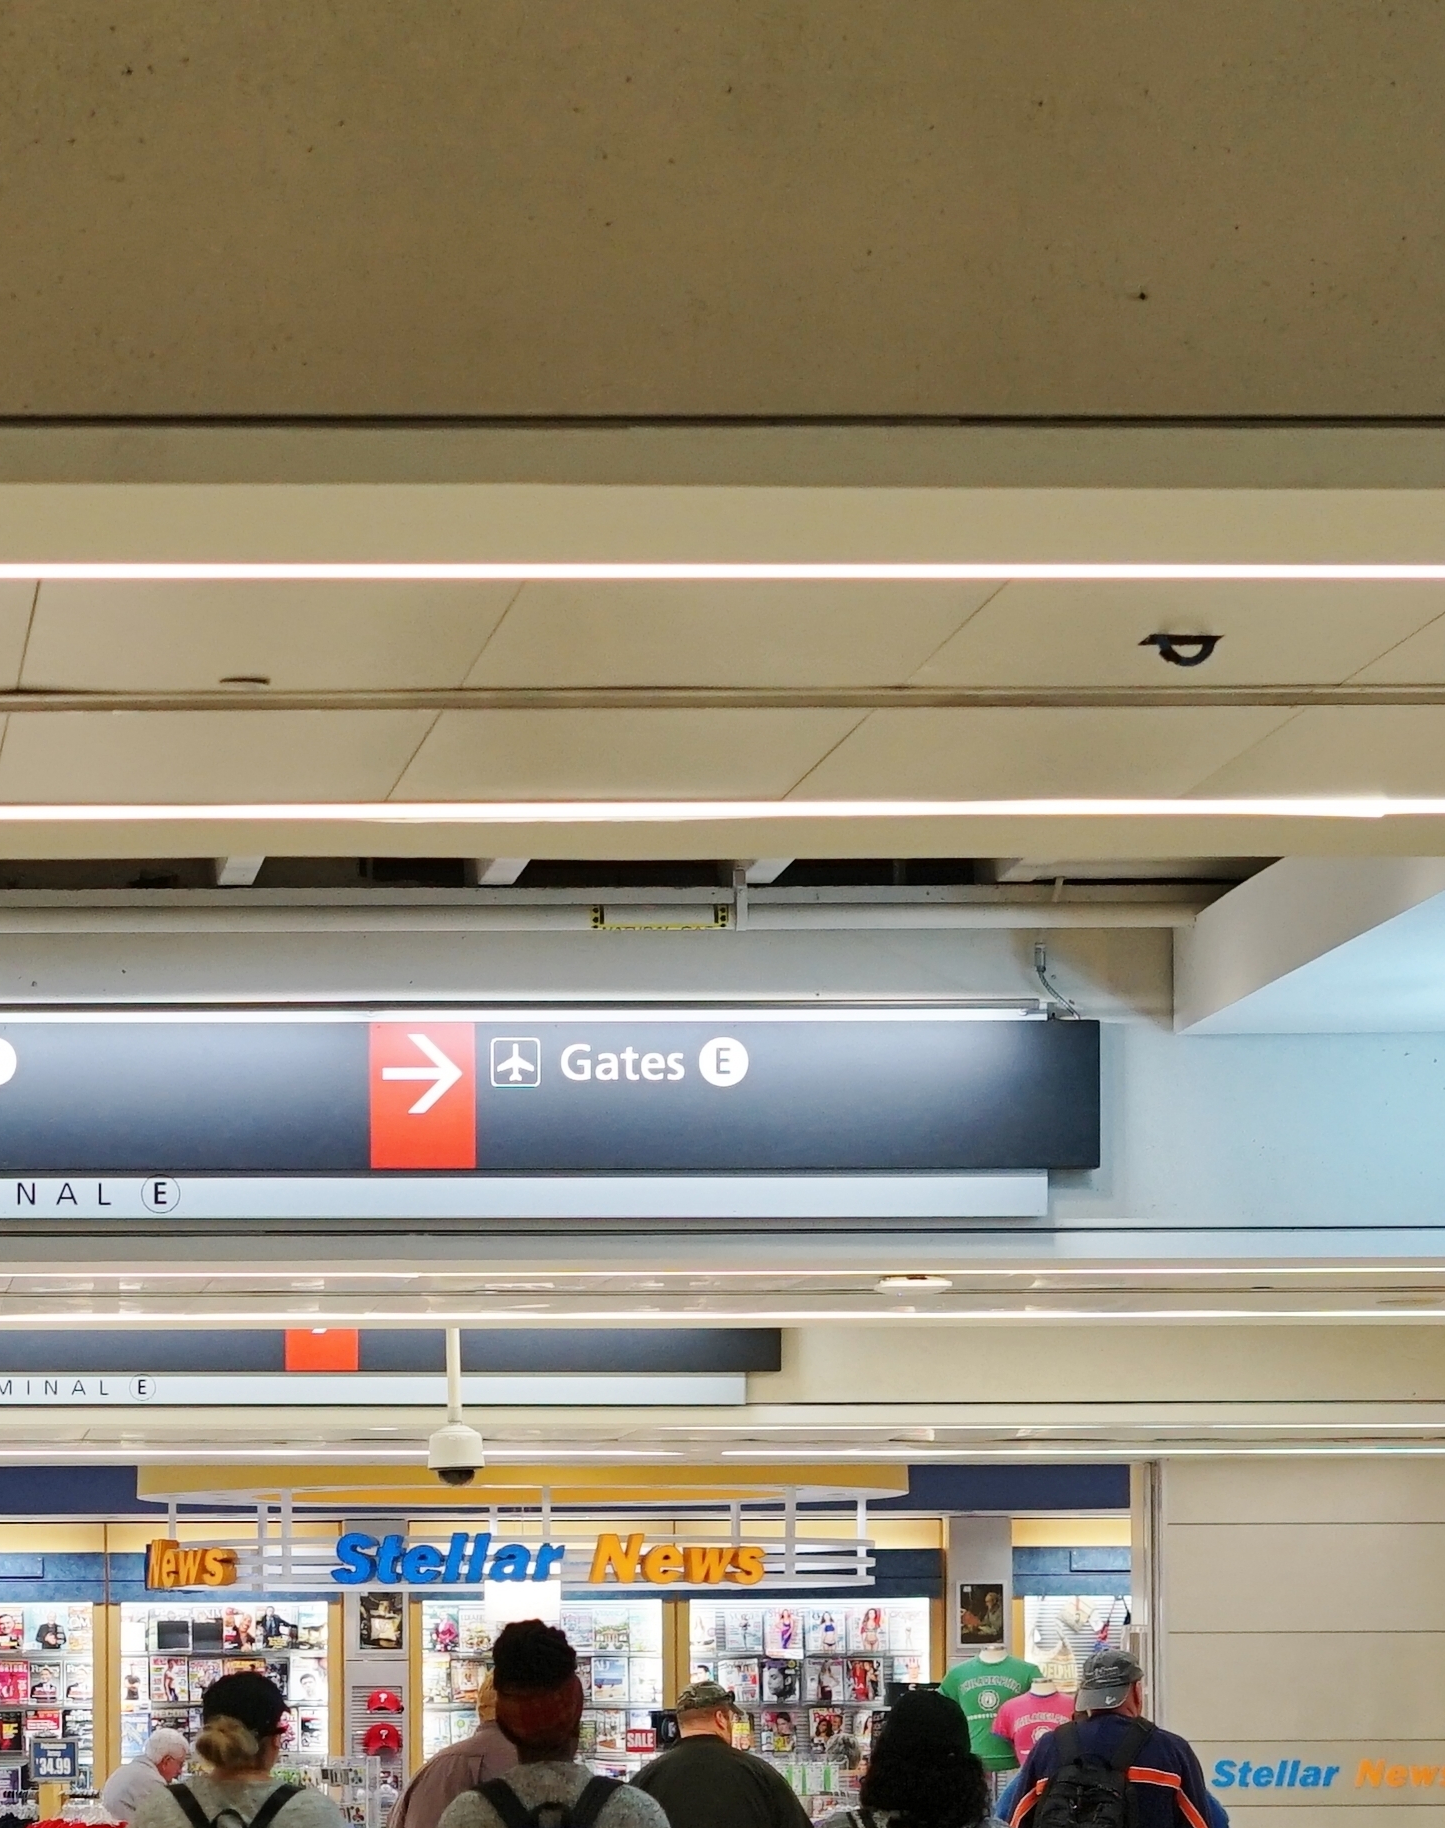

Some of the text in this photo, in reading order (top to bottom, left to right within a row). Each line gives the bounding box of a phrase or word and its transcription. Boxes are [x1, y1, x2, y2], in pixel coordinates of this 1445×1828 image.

[560, 1044, 684, 1081] Gates
[146, 1539, 231, 1591] News
[331, 1532, 766, 1585] Stellar News
[627, 1731, 654, 1747] SALE
[1211, 1758, 1340, 1788] Stellar
